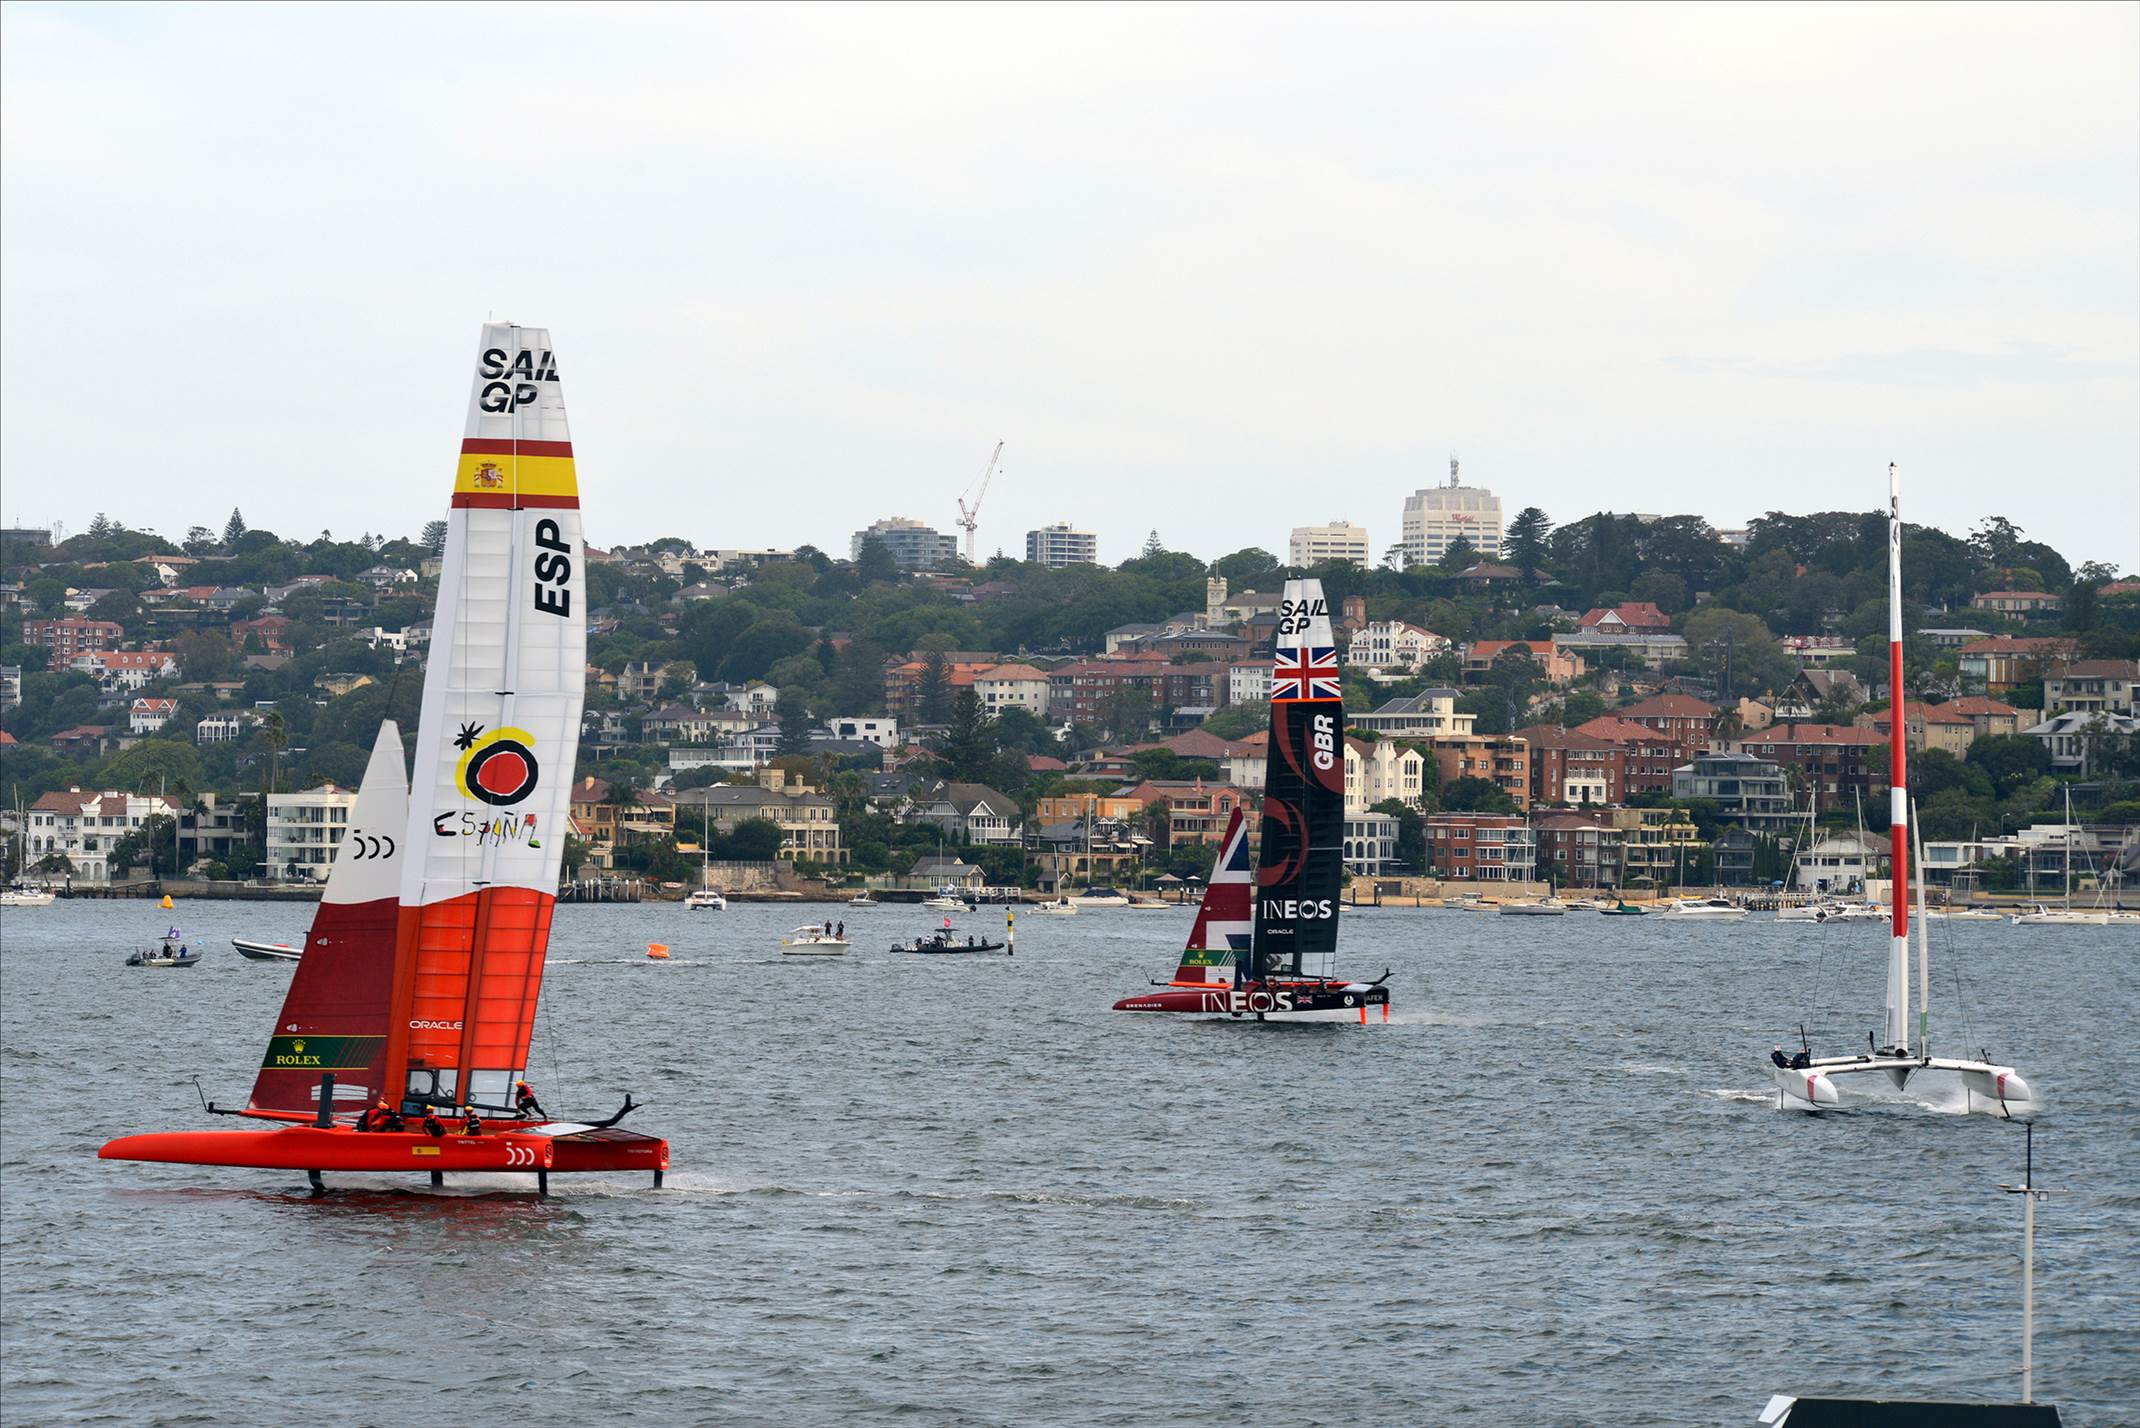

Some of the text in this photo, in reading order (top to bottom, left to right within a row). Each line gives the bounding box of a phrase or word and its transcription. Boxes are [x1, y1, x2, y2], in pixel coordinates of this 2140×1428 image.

[479, 348, 560, 381] SAIL
[479, 381, 538, 414] GP
[534, 518, 571, 618] ESP
[1280, 599, 1329, 617] SAIL
[1279, 617, 1311, 635] GP
[1314, 713, 1334, 770] GBR
[434, 811, 541, 848] ESPAÑA
[1263, 899, 1332, 919] INEOS
[1201, 991, 1293, 1012] INEOS
[409, 1020, 463, 1030] ORACLE
[276, 1055, 321, 1065] ROLEX
